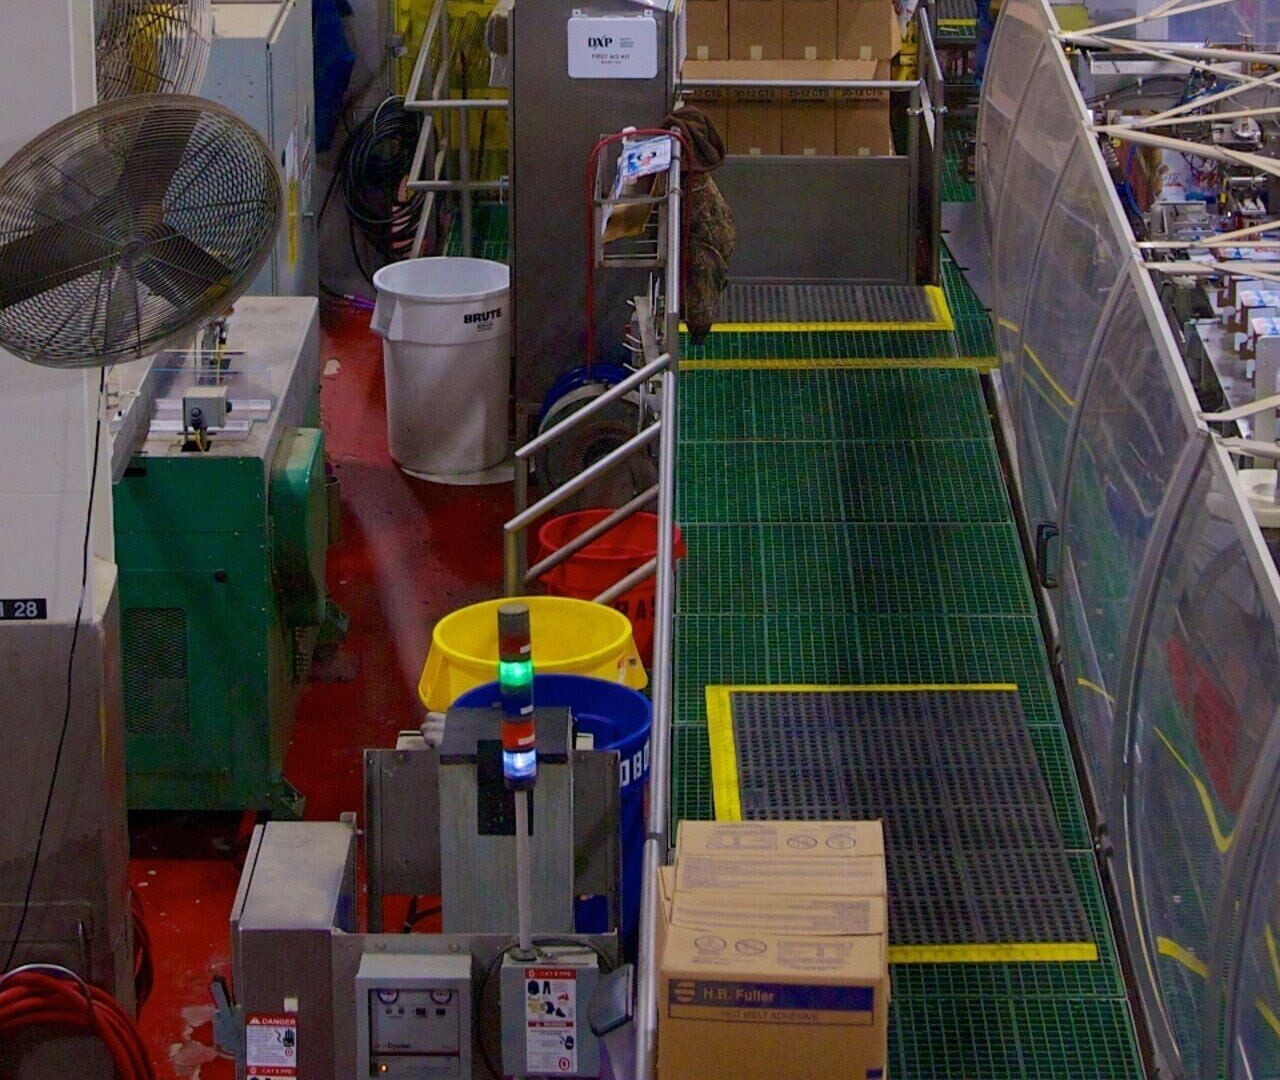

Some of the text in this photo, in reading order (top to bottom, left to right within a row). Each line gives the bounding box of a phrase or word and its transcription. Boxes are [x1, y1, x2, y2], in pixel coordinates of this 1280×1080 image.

[588, 36, 613, 49] DXP
[464, 307, 503, 324] BRUTE
[14, 601, 38, 617] 28
[703, 987, 775, 1002] H.B. Fuller
